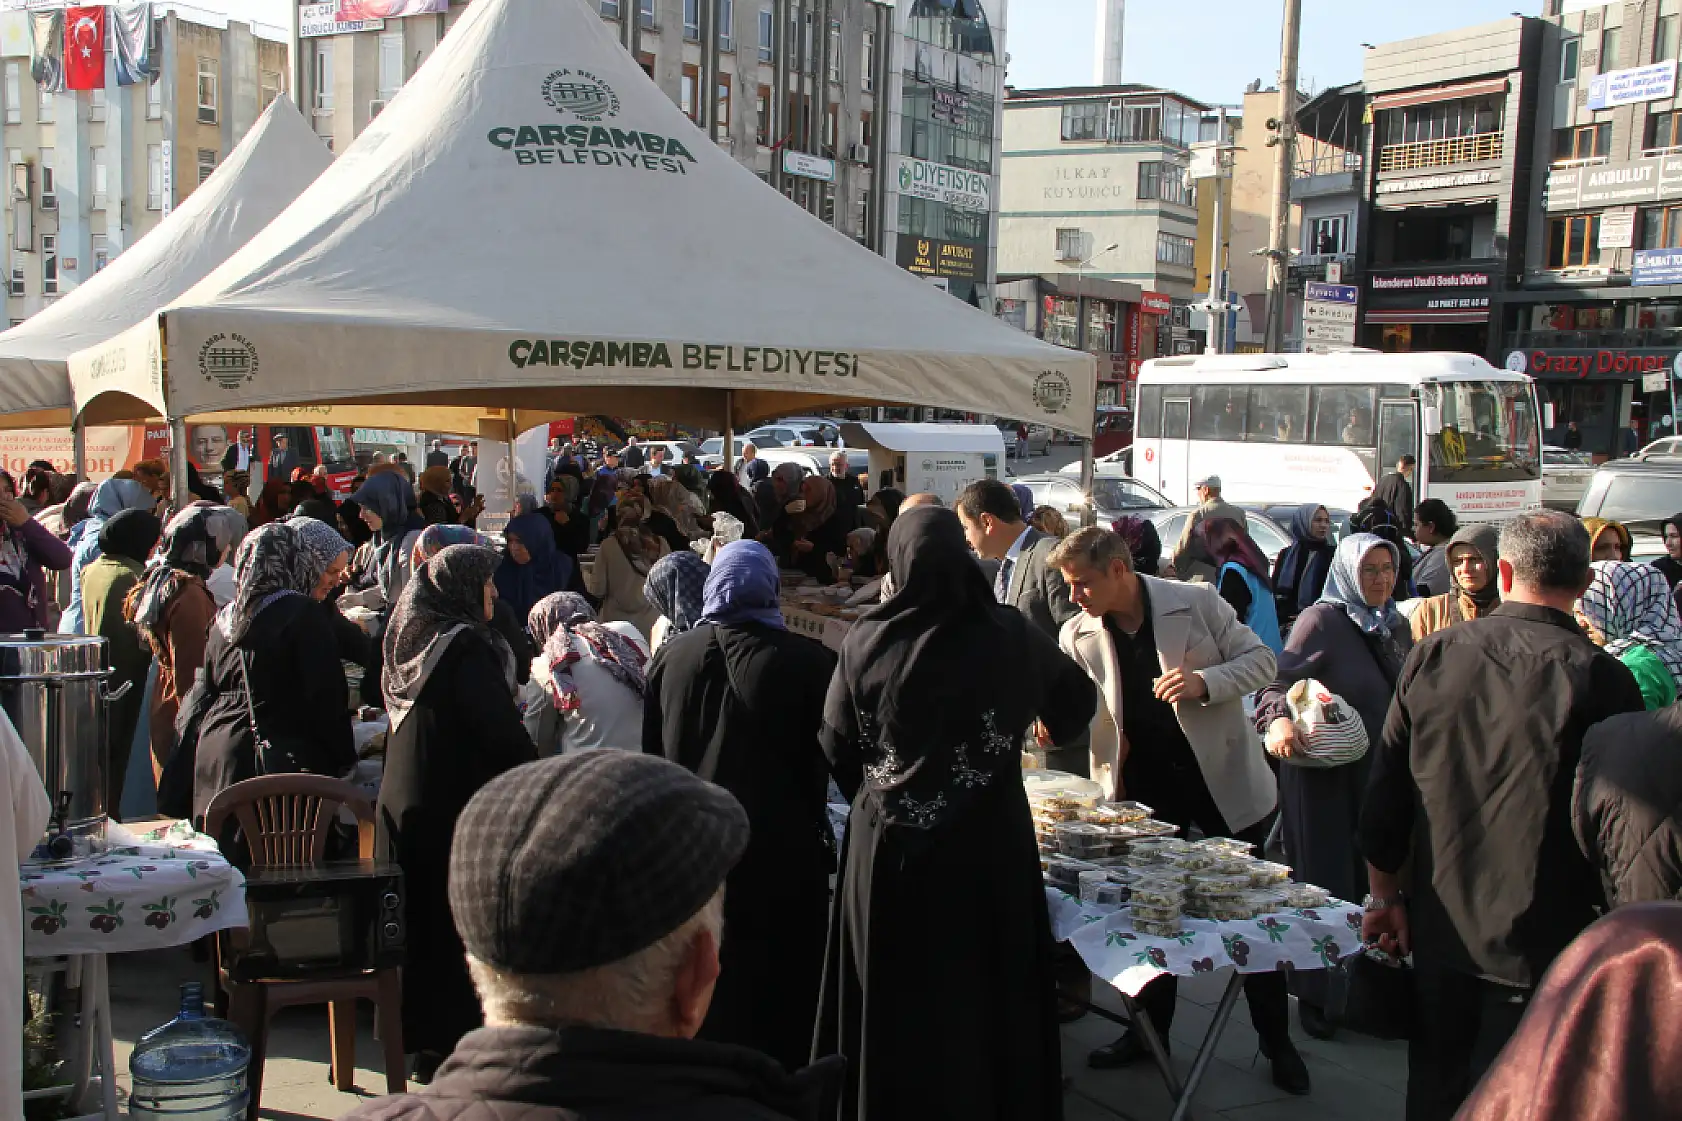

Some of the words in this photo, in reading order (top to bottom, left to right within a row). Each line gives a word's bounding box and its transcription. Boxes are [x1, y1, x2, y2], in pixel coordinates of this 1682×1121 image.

[487, 125, 698, 163] ÇARŞAMBA
[514, 149, 686, 175] BELEDİYESİ
[508, 339, 673, 369] ÇARŞAMBA
[682, 343, 858, 378] BELEDİYESİ
[1531, 350, 1592, 378] Crazy
[1597, 350, 1668, 373] Döner
